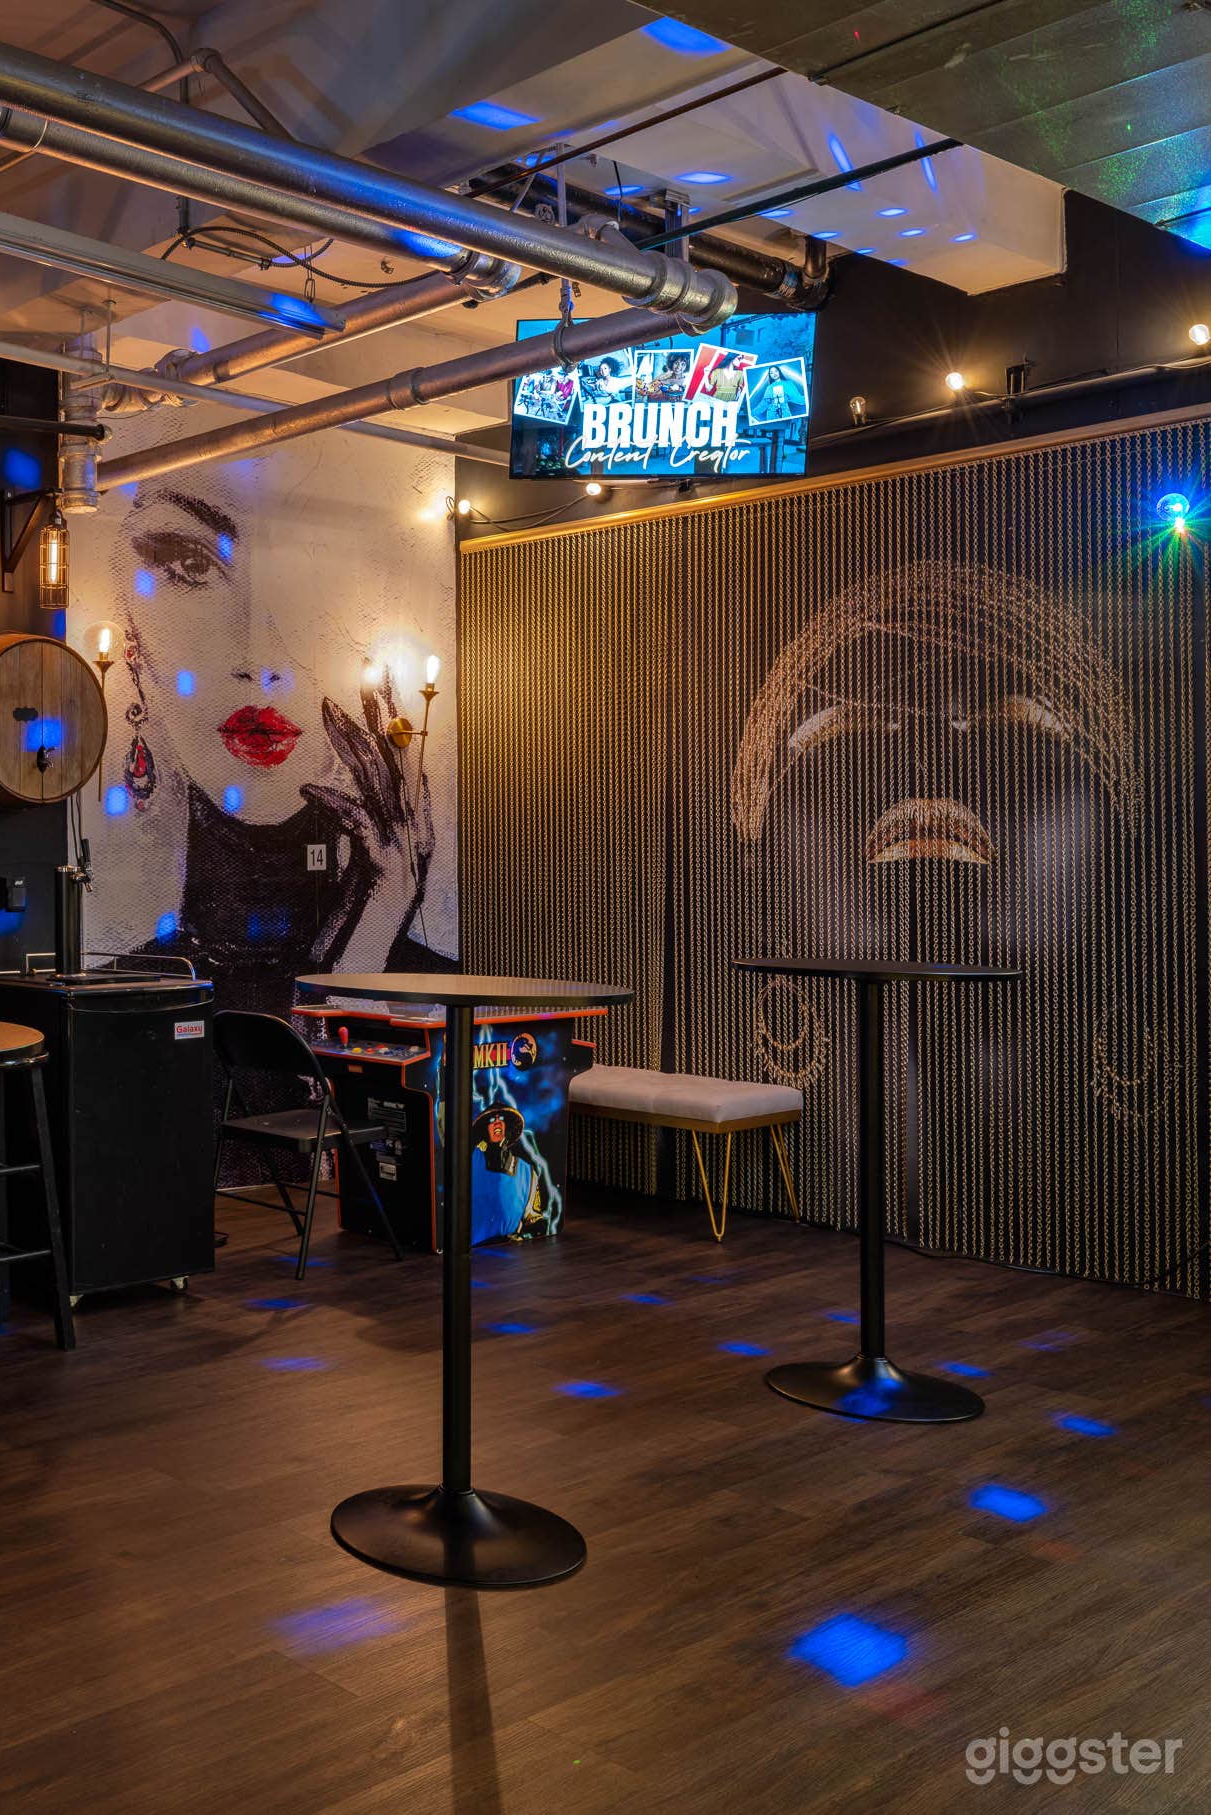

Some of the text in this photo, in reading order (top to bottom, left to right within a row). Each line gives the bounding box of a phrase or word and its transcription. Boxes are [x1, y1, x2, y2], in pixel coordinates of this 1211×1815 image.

[582, 401, 739, 450] BRUNCH
[565, 434, 752, 472] Content Creator
[310, 849, 324, 867] 14
[176, 1025, 203, 1035] Galaxy
